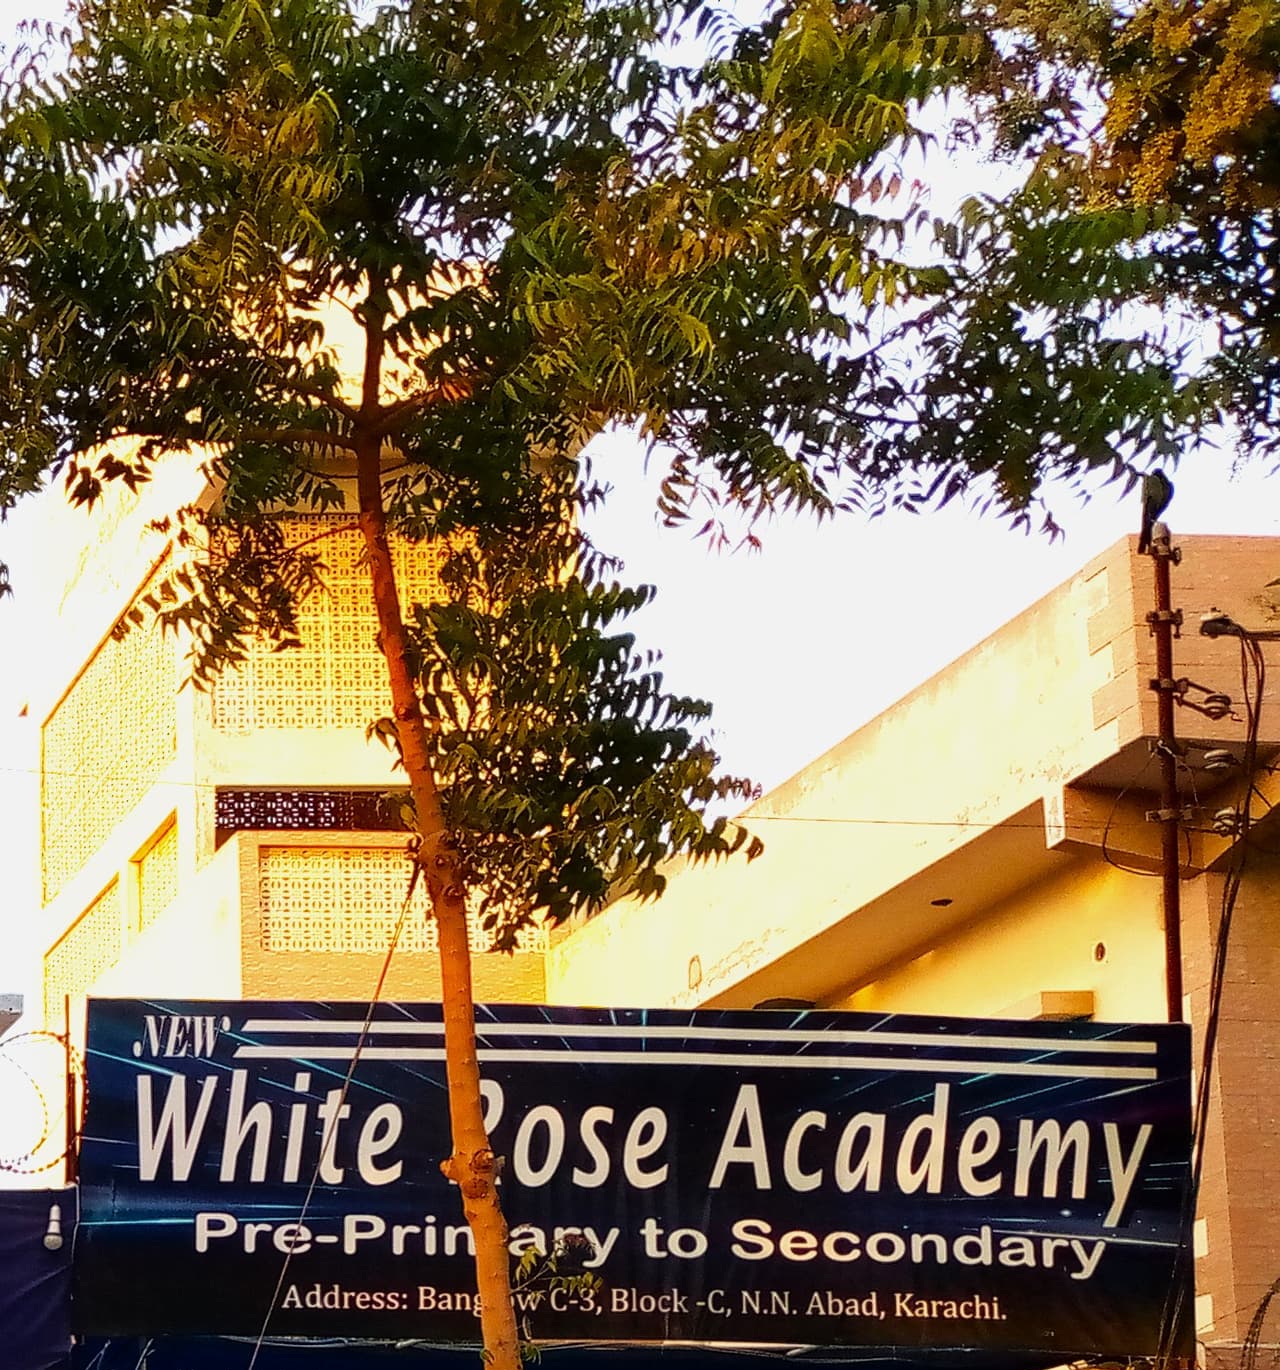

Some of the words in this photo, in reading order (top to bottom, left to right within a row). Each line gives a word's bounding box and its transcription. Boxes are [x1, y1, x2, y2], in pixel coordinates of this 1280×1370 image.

[133, 1014, 231, 1058] NEW
[137, 1069, 404, 1186] White
[709, 1082, 1153, 1228] Academy
[640, 1217, 708, 1259] to
[731, 1218, 1106, 1280] Secondary
[281, 1283, 408, 1312] Address:
[550, 1288, 603, 1316] C-3,
[611, 1288, 688, 1315] Block
[741, 1291, 797, 1316] N.N.
[805, 1292, 886, 1321] Abad,
[894, 1293, 1007, 1321] Karachi.
